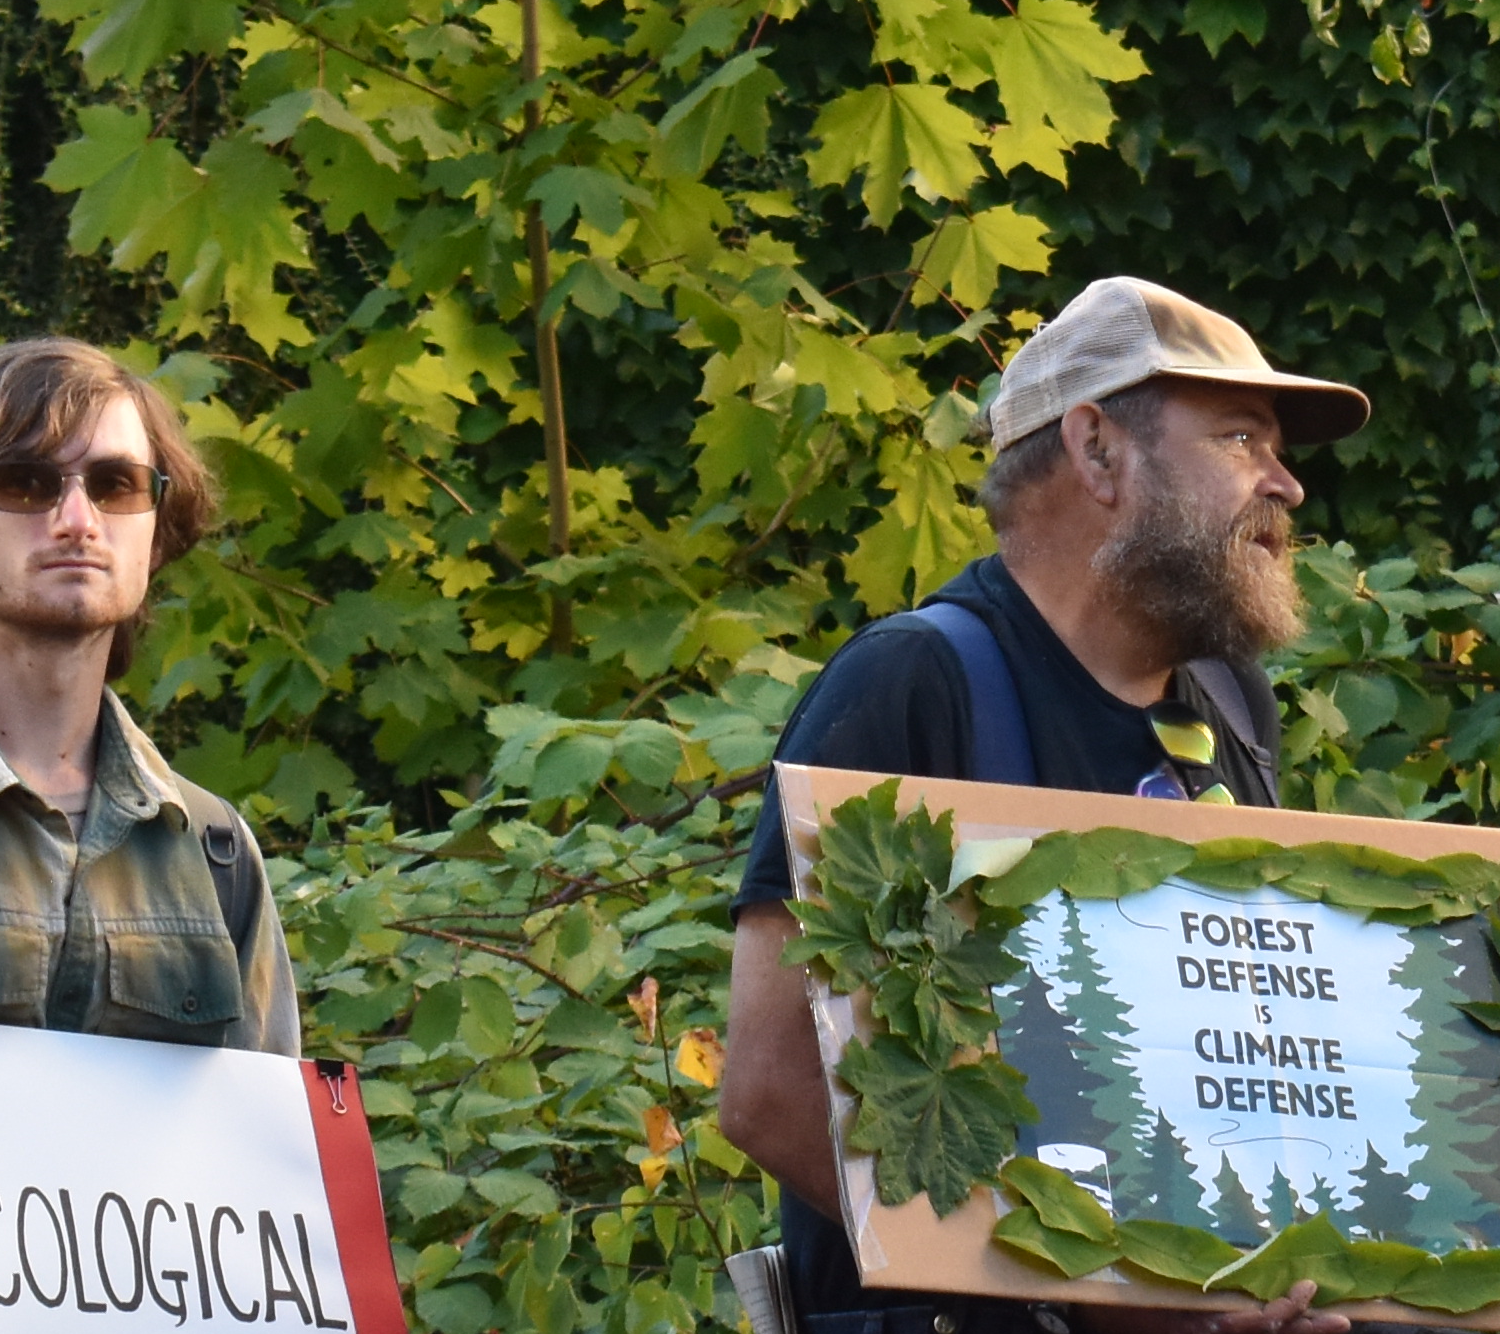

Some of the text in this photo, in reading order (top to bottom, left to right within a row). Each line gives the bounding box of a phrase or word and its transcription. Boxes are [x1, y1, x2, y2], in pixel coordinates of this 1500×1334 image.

[1181, 912, 1314, 954] FOREST
[1177, 955, 1338, 1001] DEFENSE
[1254, 1003, 1273, 1025] IS
[1195, 1029, 1345, 1073] CLIMATE
[1195, 1075, 1357, 1120] DEFENSE
